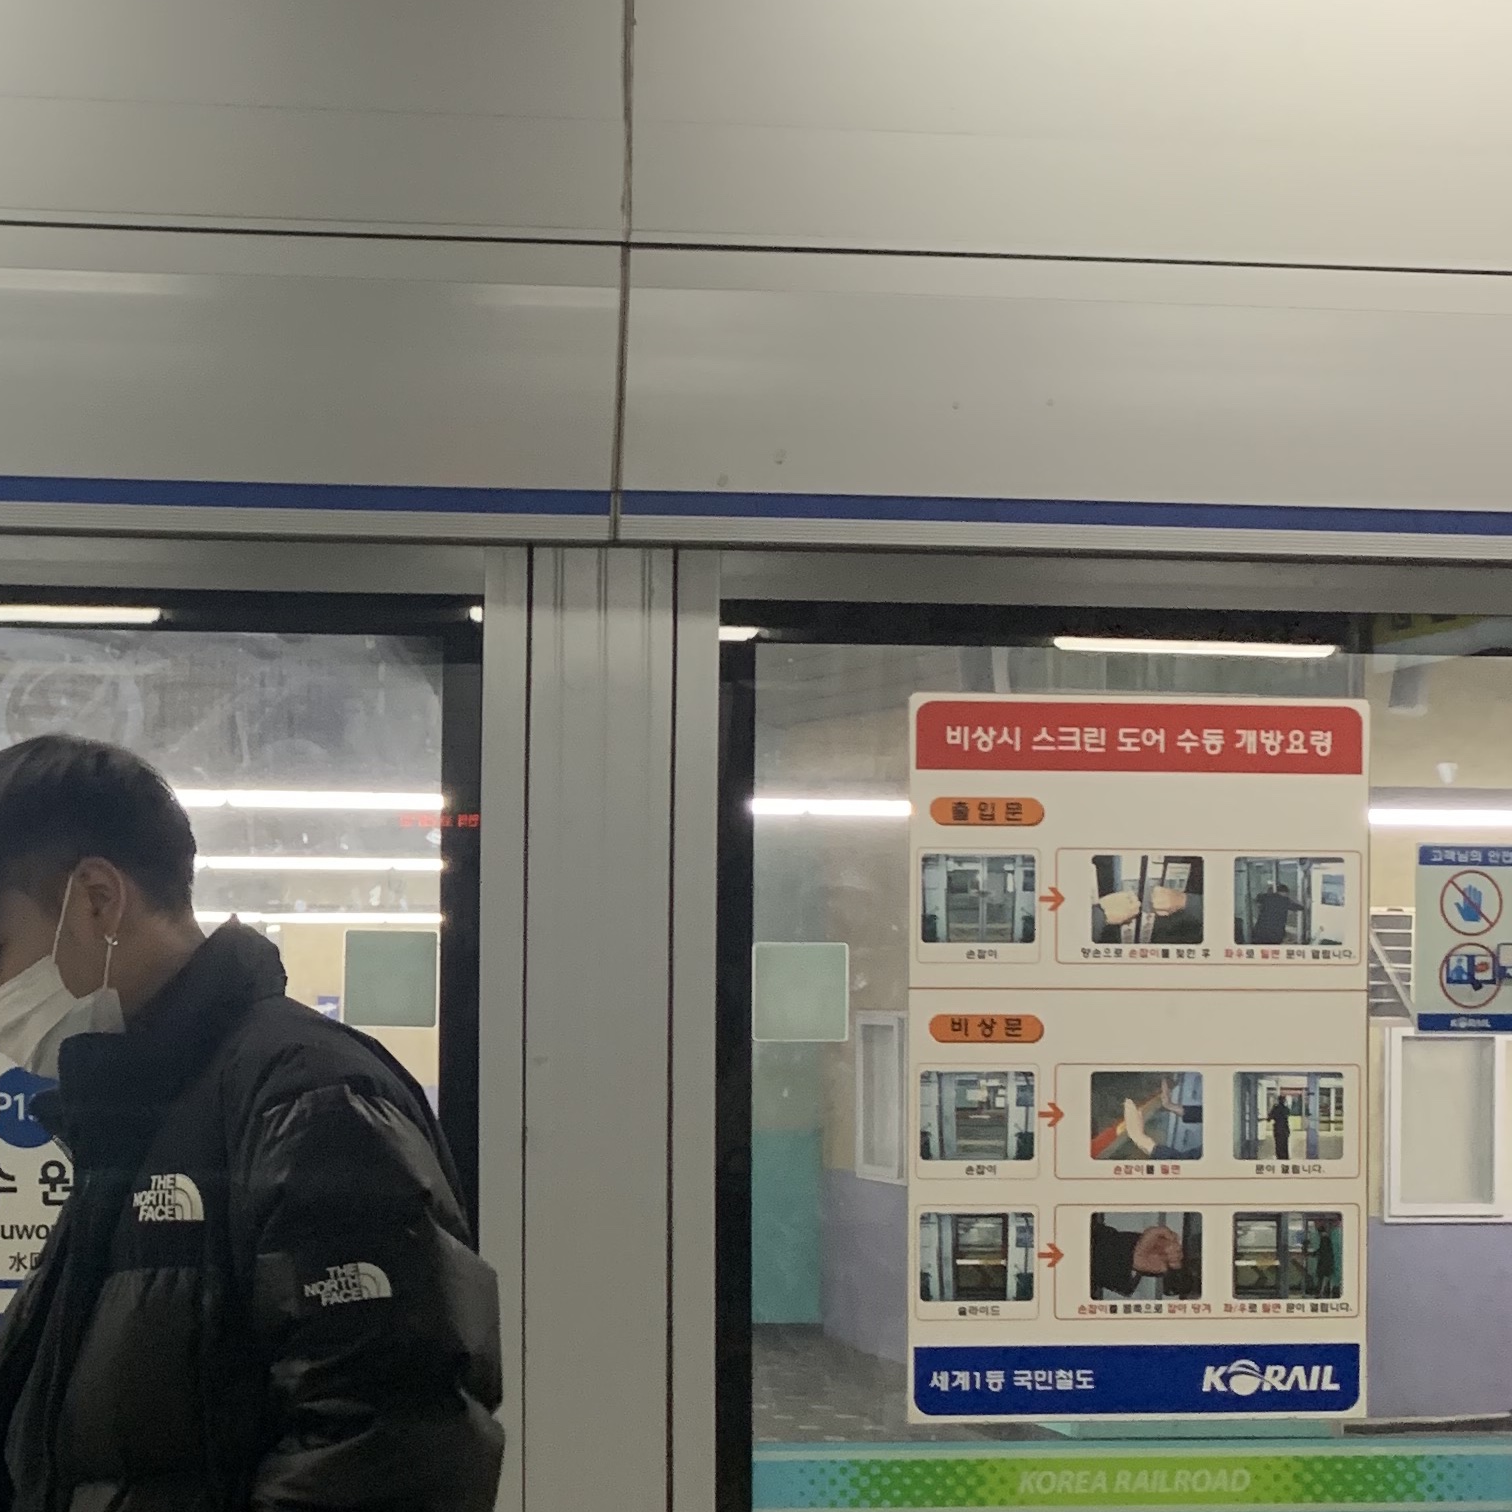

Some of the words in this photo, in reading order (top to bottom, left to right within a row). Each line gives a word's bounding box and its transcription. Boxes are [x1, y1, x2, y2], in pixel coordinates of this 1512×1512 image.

[945, 725, 1022, 752] 비상시
[1031, 726, 1107, 753] 스크린
[1116, 727, 1166, 754] 도어
[1176, 727, 1226, 755] 수동
[1235, 728, 1334, 757] 개방요령
[950, 1017, 1023, 1038] 비상문
[965, 1164, 997, 1176] 손잡이
[150, 1173, 176, 1190] THE
[132, 1189, 175, 1208] NORTH
[138, 1205, 176, 1222] FACE
[325, 1262, 359, 1281] THE
[303, 1275, 361, 1298] NORTH
[320, 1287, 364, 1307] FACE
[928, 1369, 1006, 1393] 세계1등
[1012, 1369, 1096, 1392] 국민철도
[1201, 1358, 1341, 1397] KORAIL
[1018, 1468, 1108, 1495] KOREA
[1114, 1467, 1252, 1494] RAILROAD
